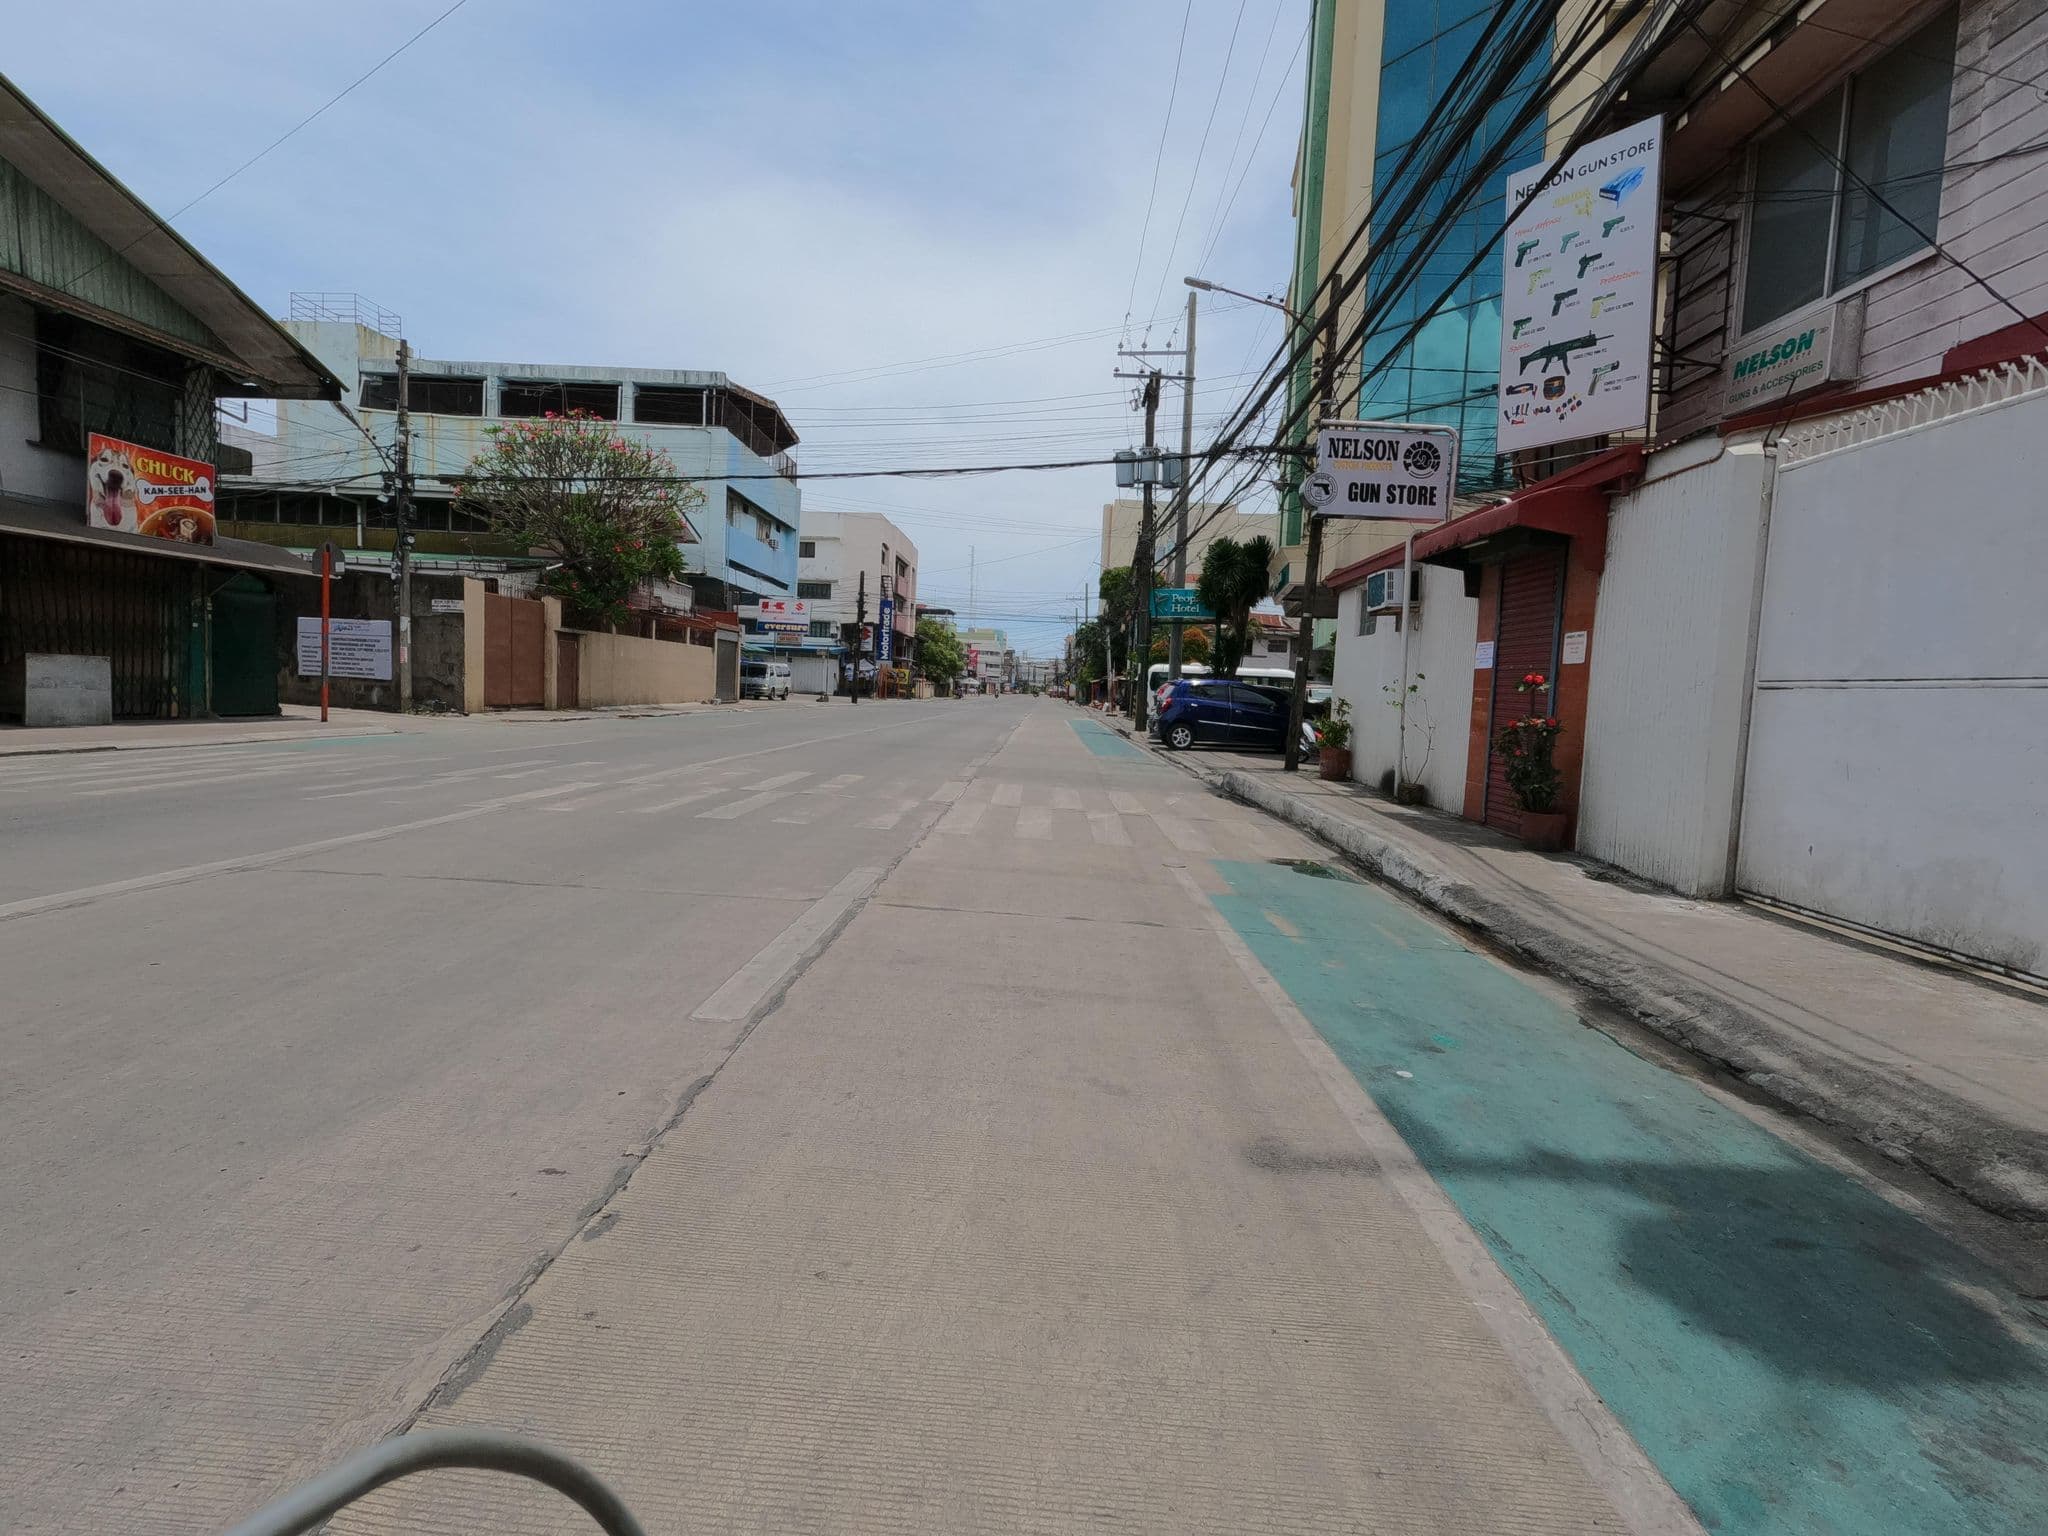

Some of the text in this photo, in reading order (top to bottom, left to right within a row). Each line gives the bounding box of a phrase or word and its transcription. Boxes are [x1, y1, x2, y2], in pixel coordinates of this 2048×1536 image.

[1515, 168, 1575, 202] NEON
[1578, 157, 1608, 177] GUN
[1610, 138, 1656, 165] STORE
[1733, 328, 1816, 381] NELSON
[1728, 360, 1824, 404] GUNS & ACCESSORIES
[1327, 437, 1400, 462] NELSON
[135, 457, 195, 485] CHUCK
[144, 486, 207, 496] KAN-SEE-HAN
[1348, 482, 1381, 504] GUN
[1386, 484, 1438, 507] STORE
[1171, 603, 1201, 613] Hotel
[1172, 593, 1199, 606] Peop
